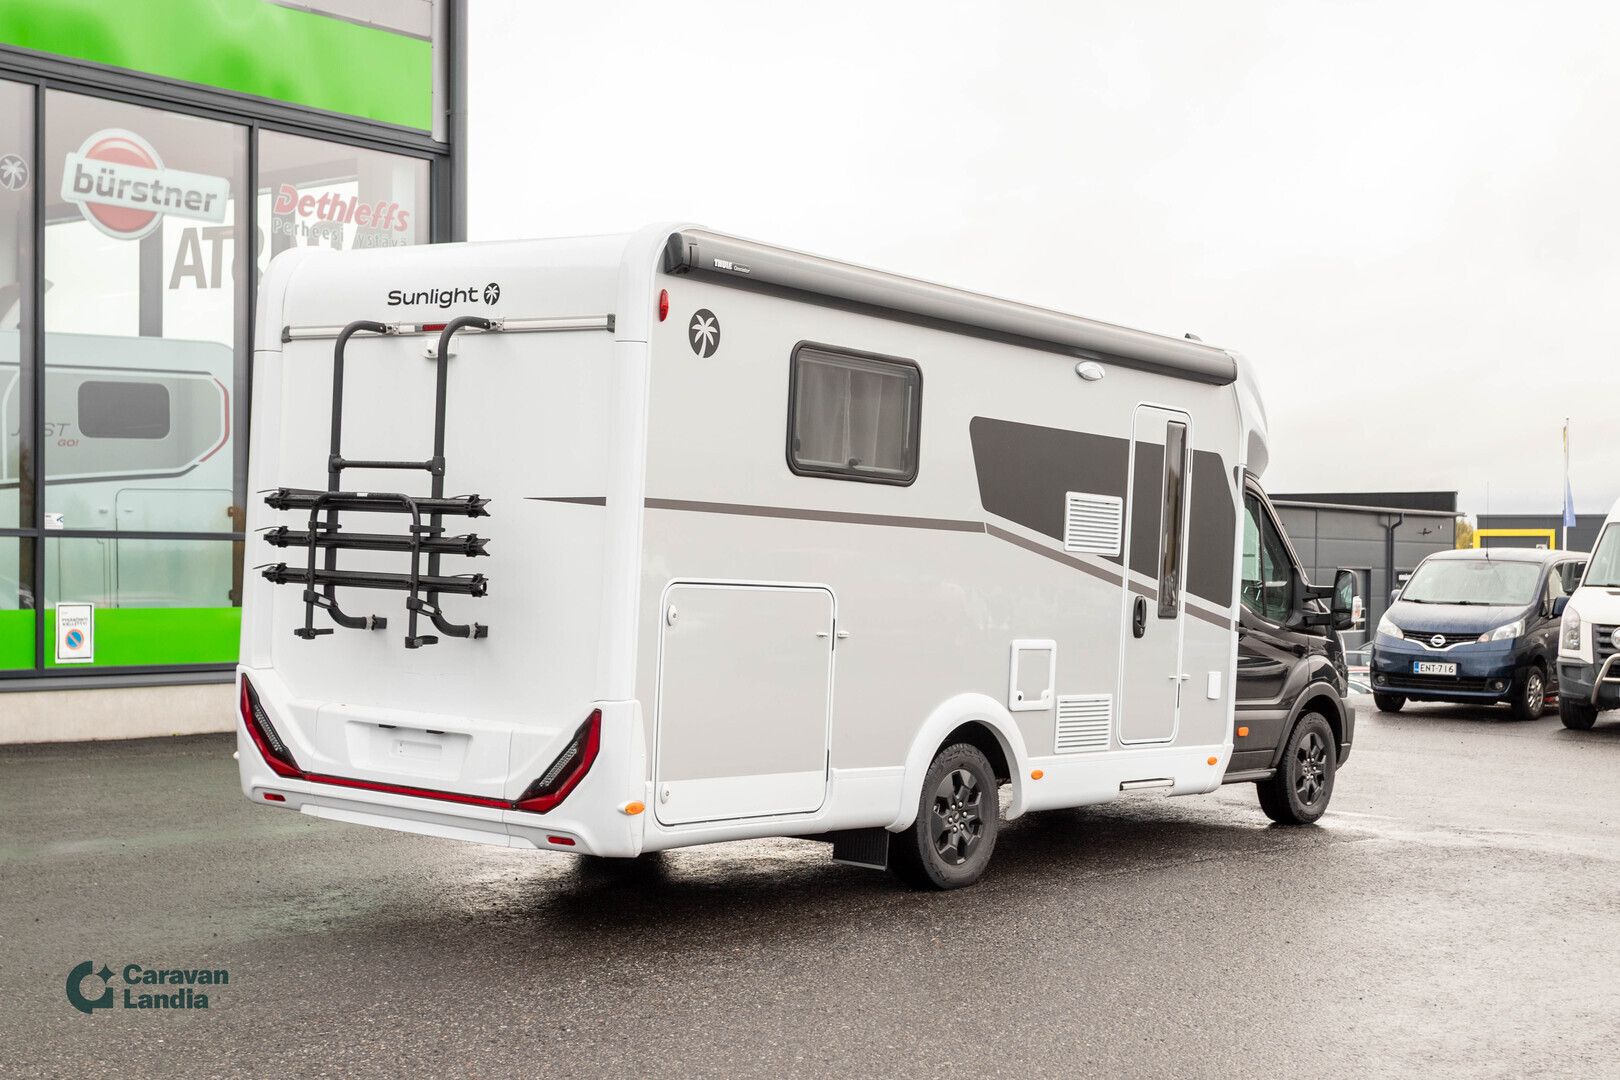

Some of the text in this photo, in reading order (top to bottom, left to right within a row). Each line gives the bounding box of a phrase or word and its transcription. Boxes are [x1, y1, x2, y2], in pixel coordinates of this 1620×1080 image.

[73, 164, 217, 212] bürstner
[274, 183, 410, 232] Dethleffs
[387, 287, 479, 308] Sunlight
[1420, 663, 1454, 674] ENT-716
